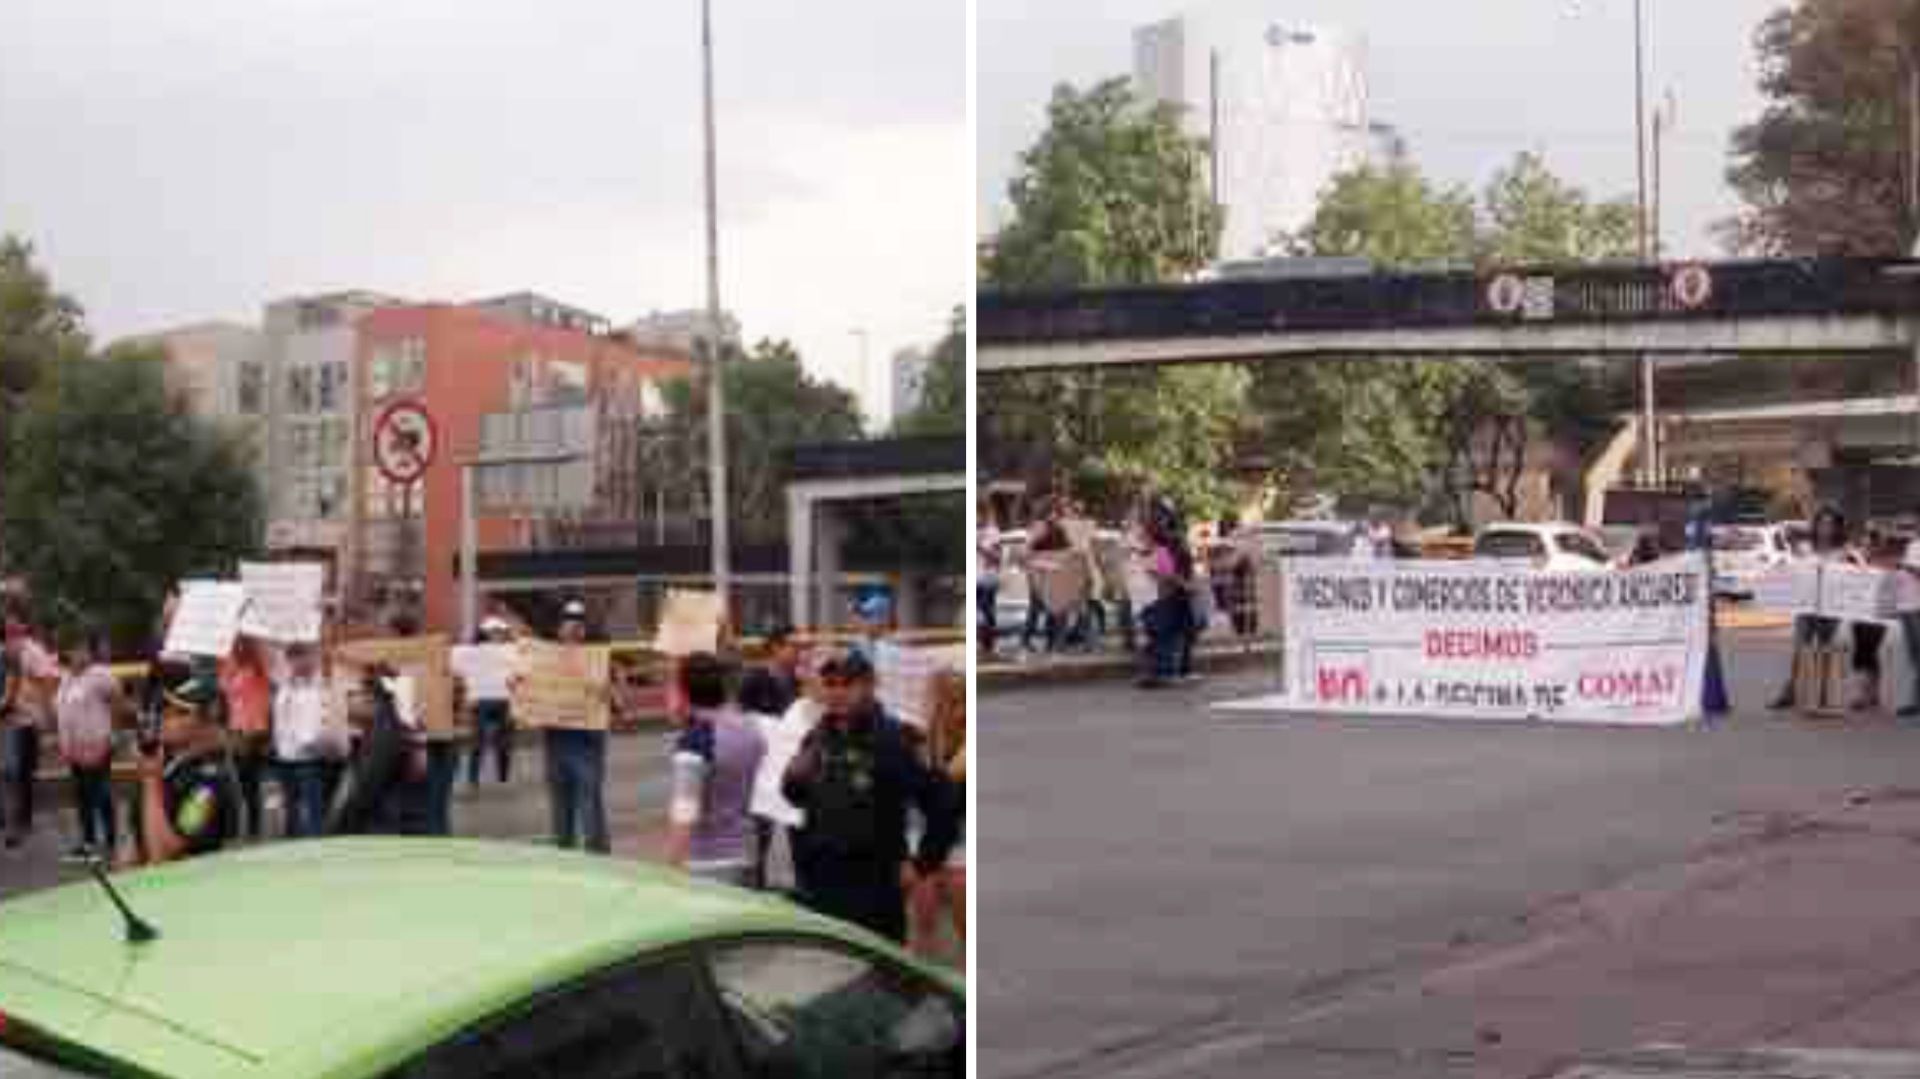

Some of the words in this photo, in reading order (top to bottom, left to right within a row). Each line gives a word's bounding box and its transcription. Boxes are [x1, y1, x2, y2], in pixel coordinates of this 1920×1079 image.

[1393, 575, 1491, 611] COMERCIOS
[1497, 575, 1520, 611] DE
[1426, 628, 1537, 658] DECIMOS
